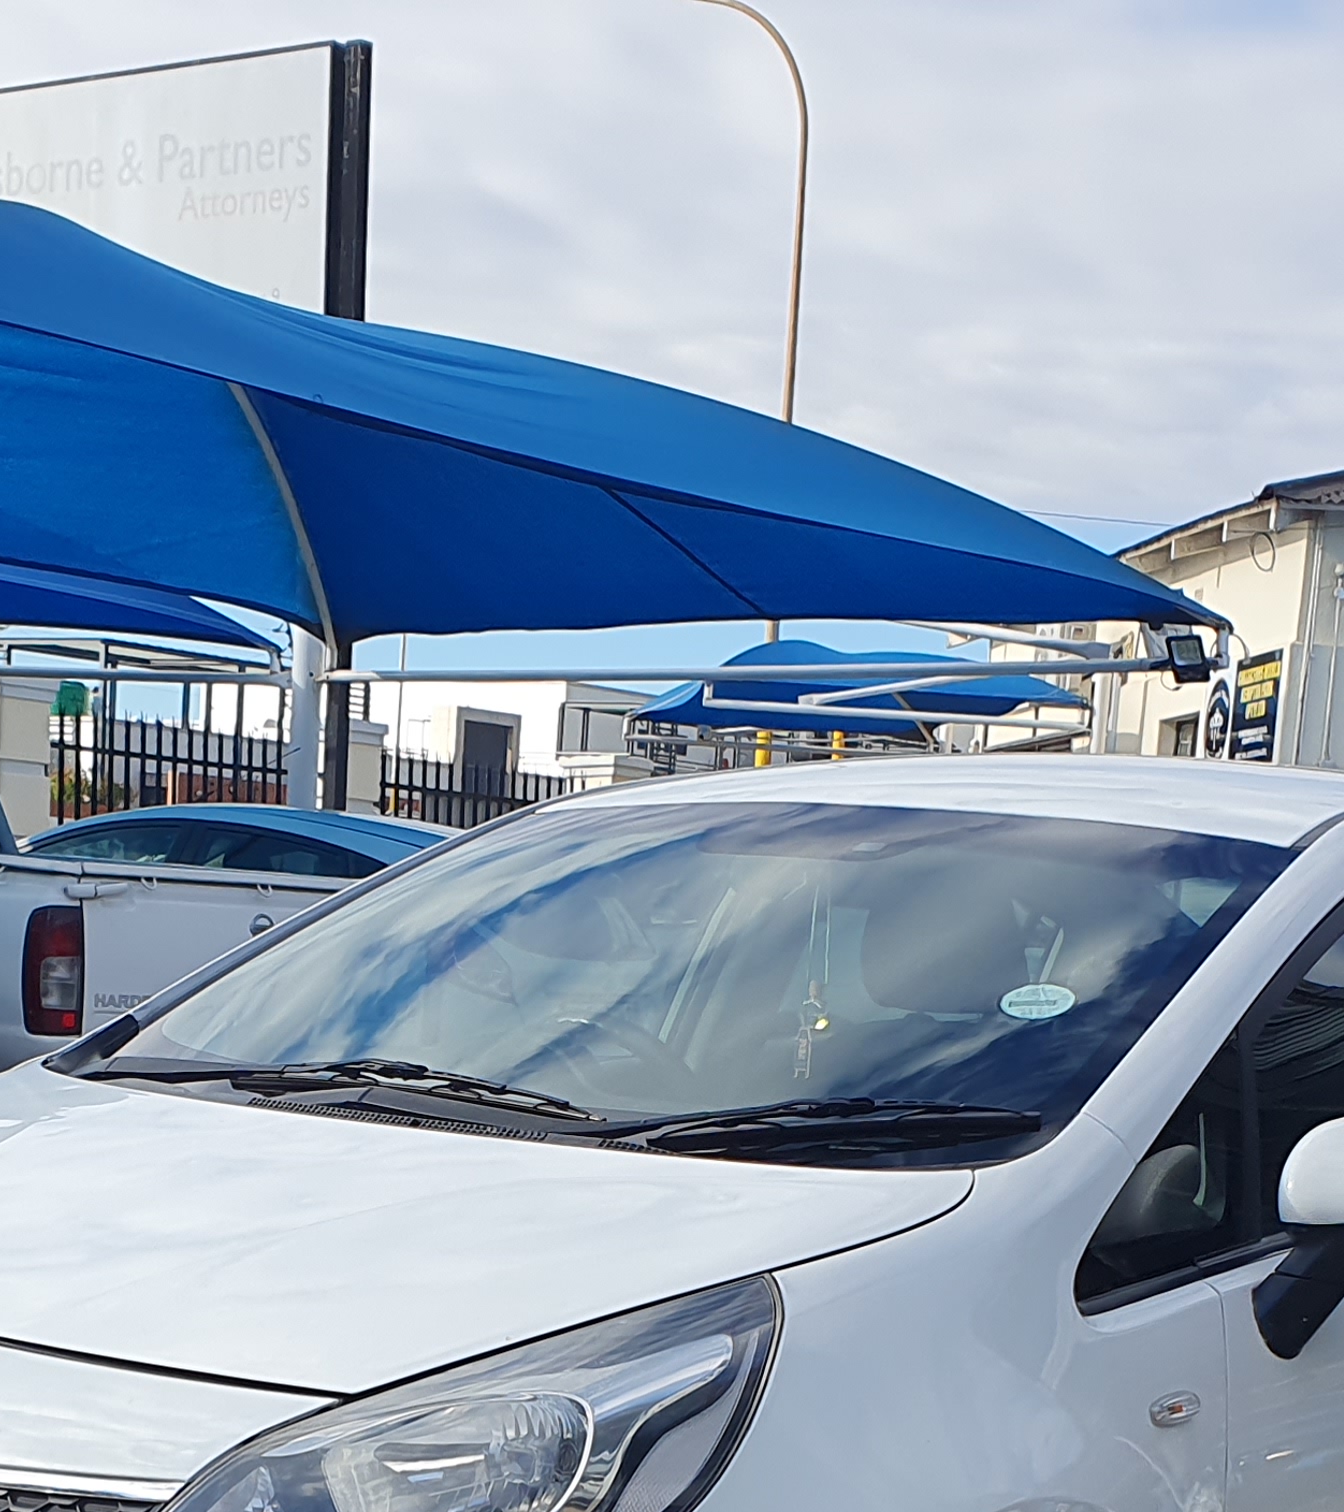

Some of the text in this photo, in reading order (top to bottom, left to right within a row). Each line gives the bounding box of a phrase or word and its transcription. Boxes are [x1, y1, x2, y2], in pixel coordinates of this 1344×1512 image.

[117, 139, 144, 186] &
[157, 132, 312, 183] Partners
[177, 184, 310, 222] Attorneys
